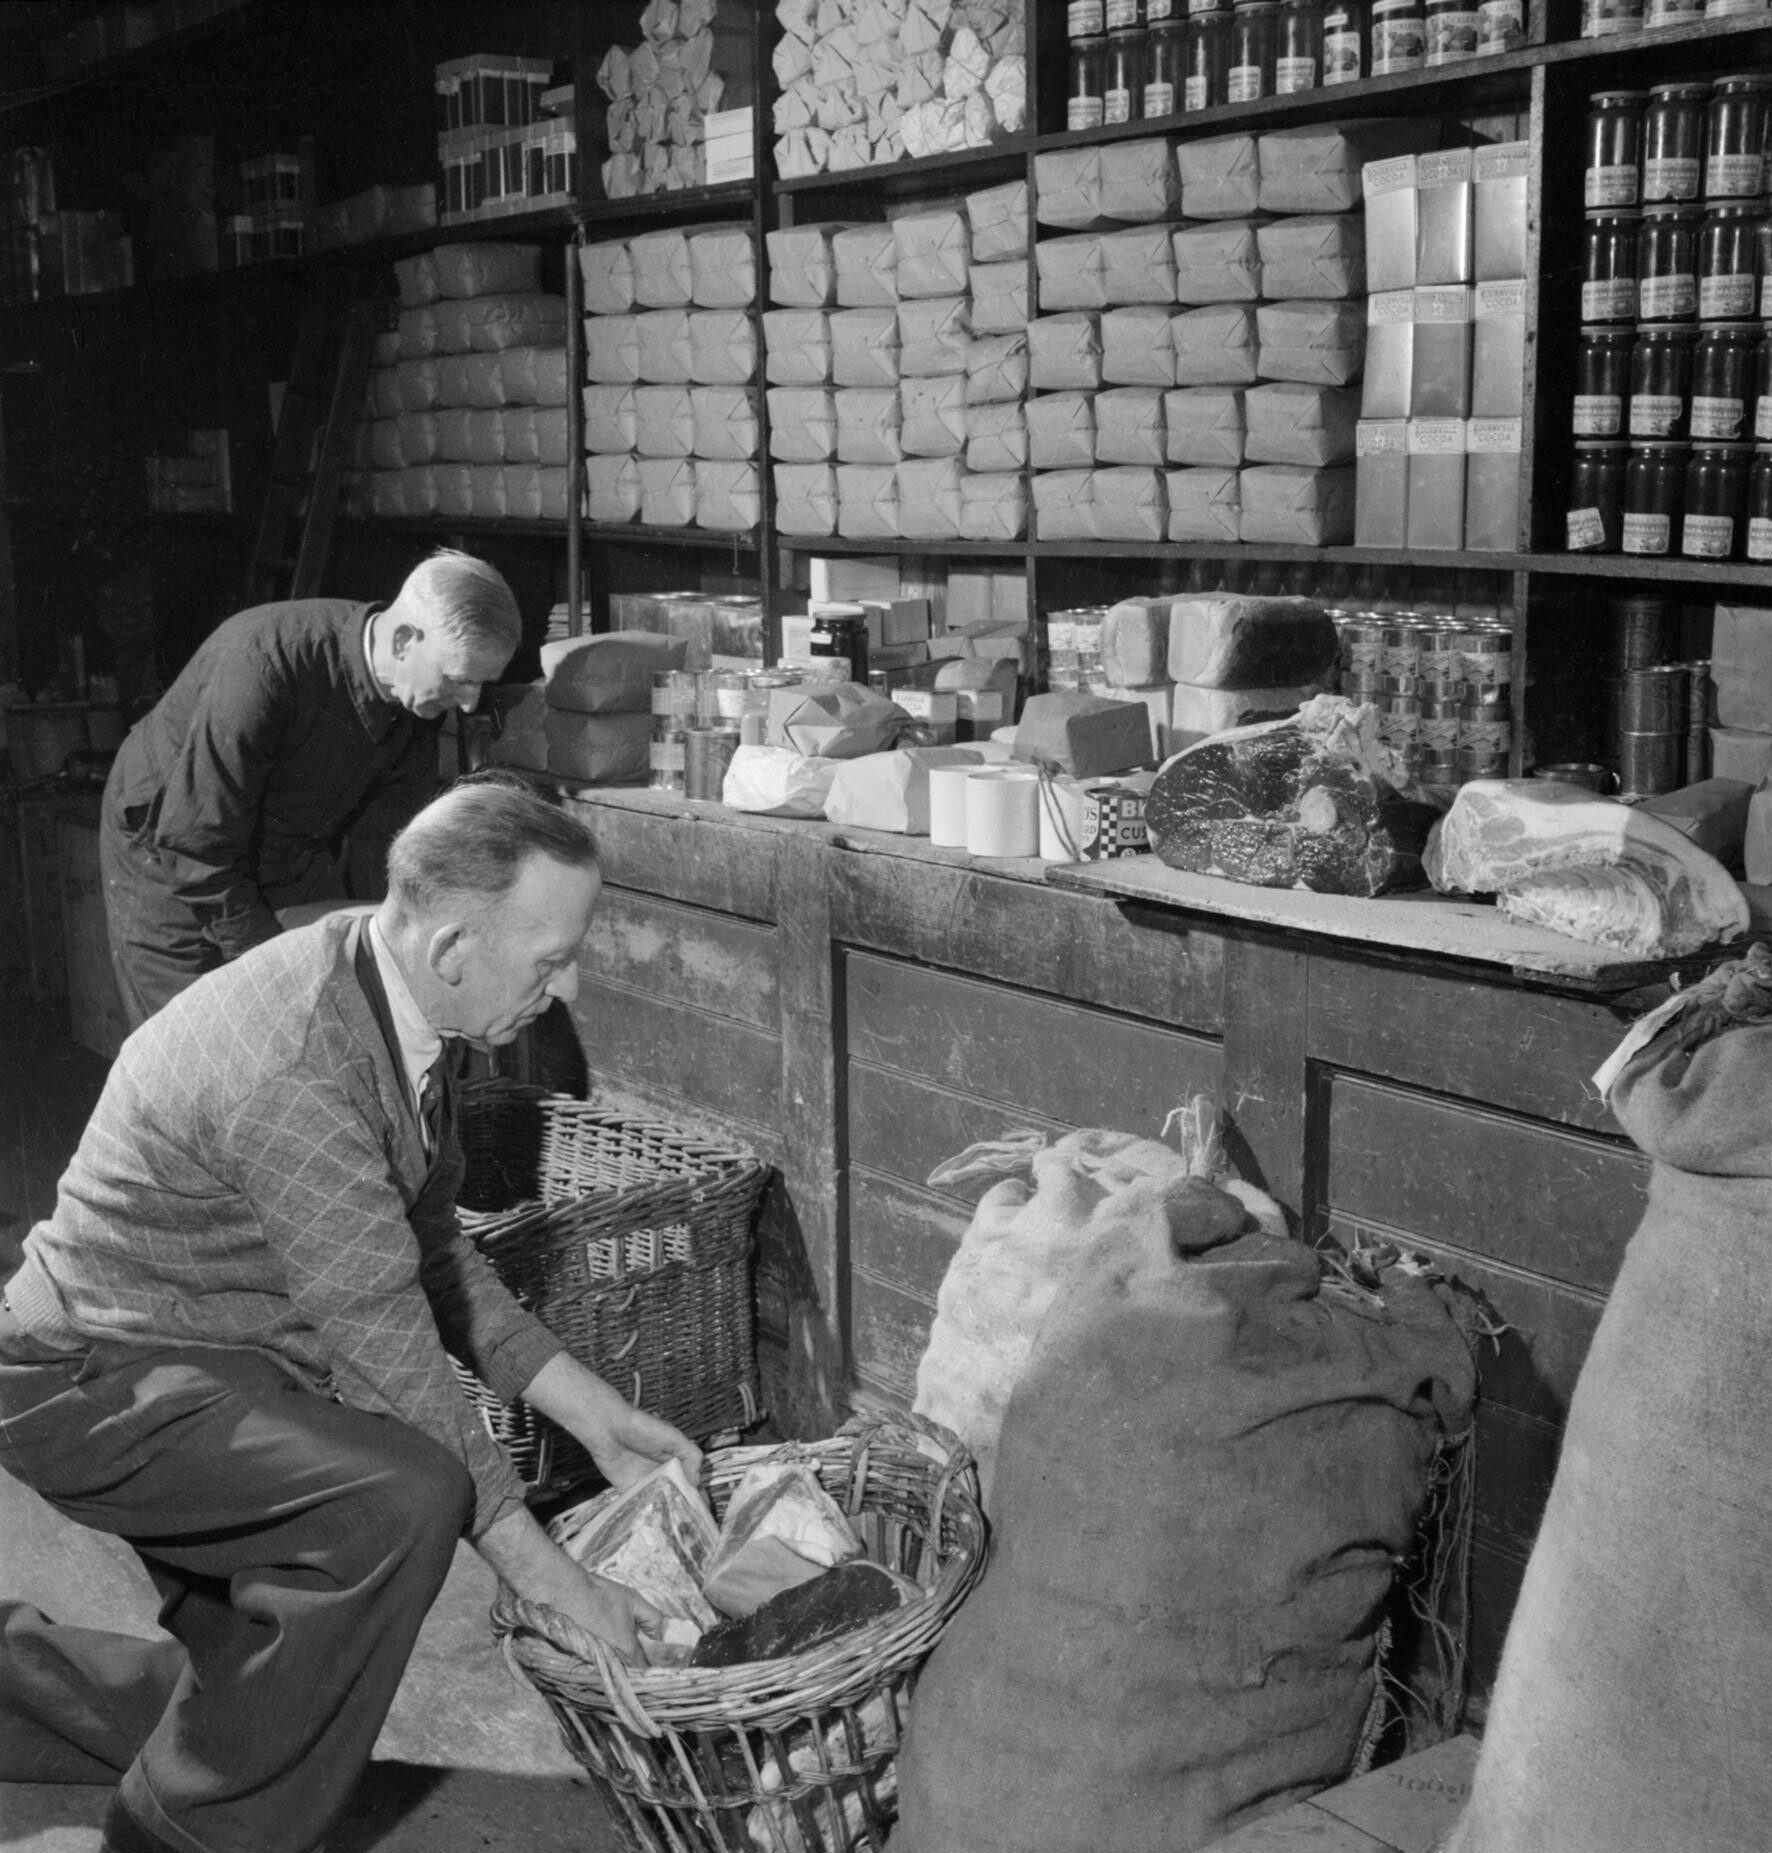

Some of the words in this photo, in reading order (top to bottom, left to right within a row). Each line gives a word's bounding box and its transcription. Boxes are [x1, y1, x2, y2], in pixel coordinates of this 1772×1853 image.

[1374, 172, 1405, 187] COCOA
[1487, 297, 1518, 309] COCOA
[1378, 304, 1409, 316] COCOA
[1420, 434, 1453, 445] COCOA
[1479, 433, 1511, 442] COCOA
